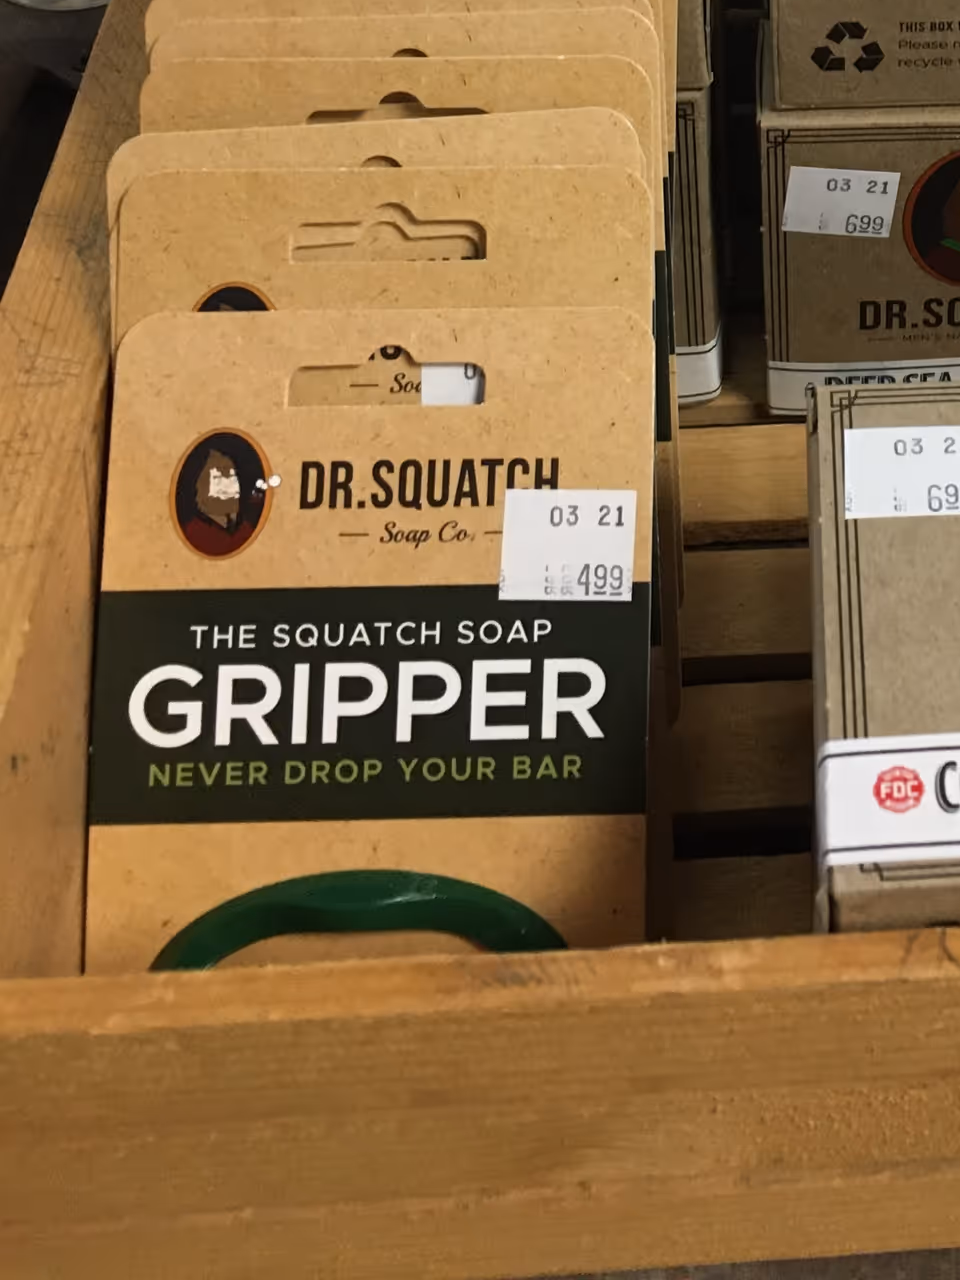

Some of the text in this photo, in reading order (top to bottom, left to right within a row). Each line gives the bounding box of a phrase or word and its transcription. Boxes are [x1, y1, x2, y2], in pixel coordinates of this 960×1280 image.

[899, 22, 926, 33] THIS
[929, 21, 954, 32] BOX
[898, 39, 948, 51] Please
[897, 54, 954, 69] recycle
[826, 178, 889, 194] 03 21
[845, 214, 885, 235] 699
[894, 438, 924, 456] 03
[300, 457, 561, 511] DR.SQUATCH
[550, 505, 624, 527] 03 21
[379, 521, 430, 546] Soap
[577, 563, 623, 596] 499
[190, 619, 553, 650] THE SQUATCH SOAP
[127, 657, 608, 749] GRIPPER
[149, 754, 583, 788] NEVER DROP YOUR BAR
[879, 779, 919, 799] FDC
